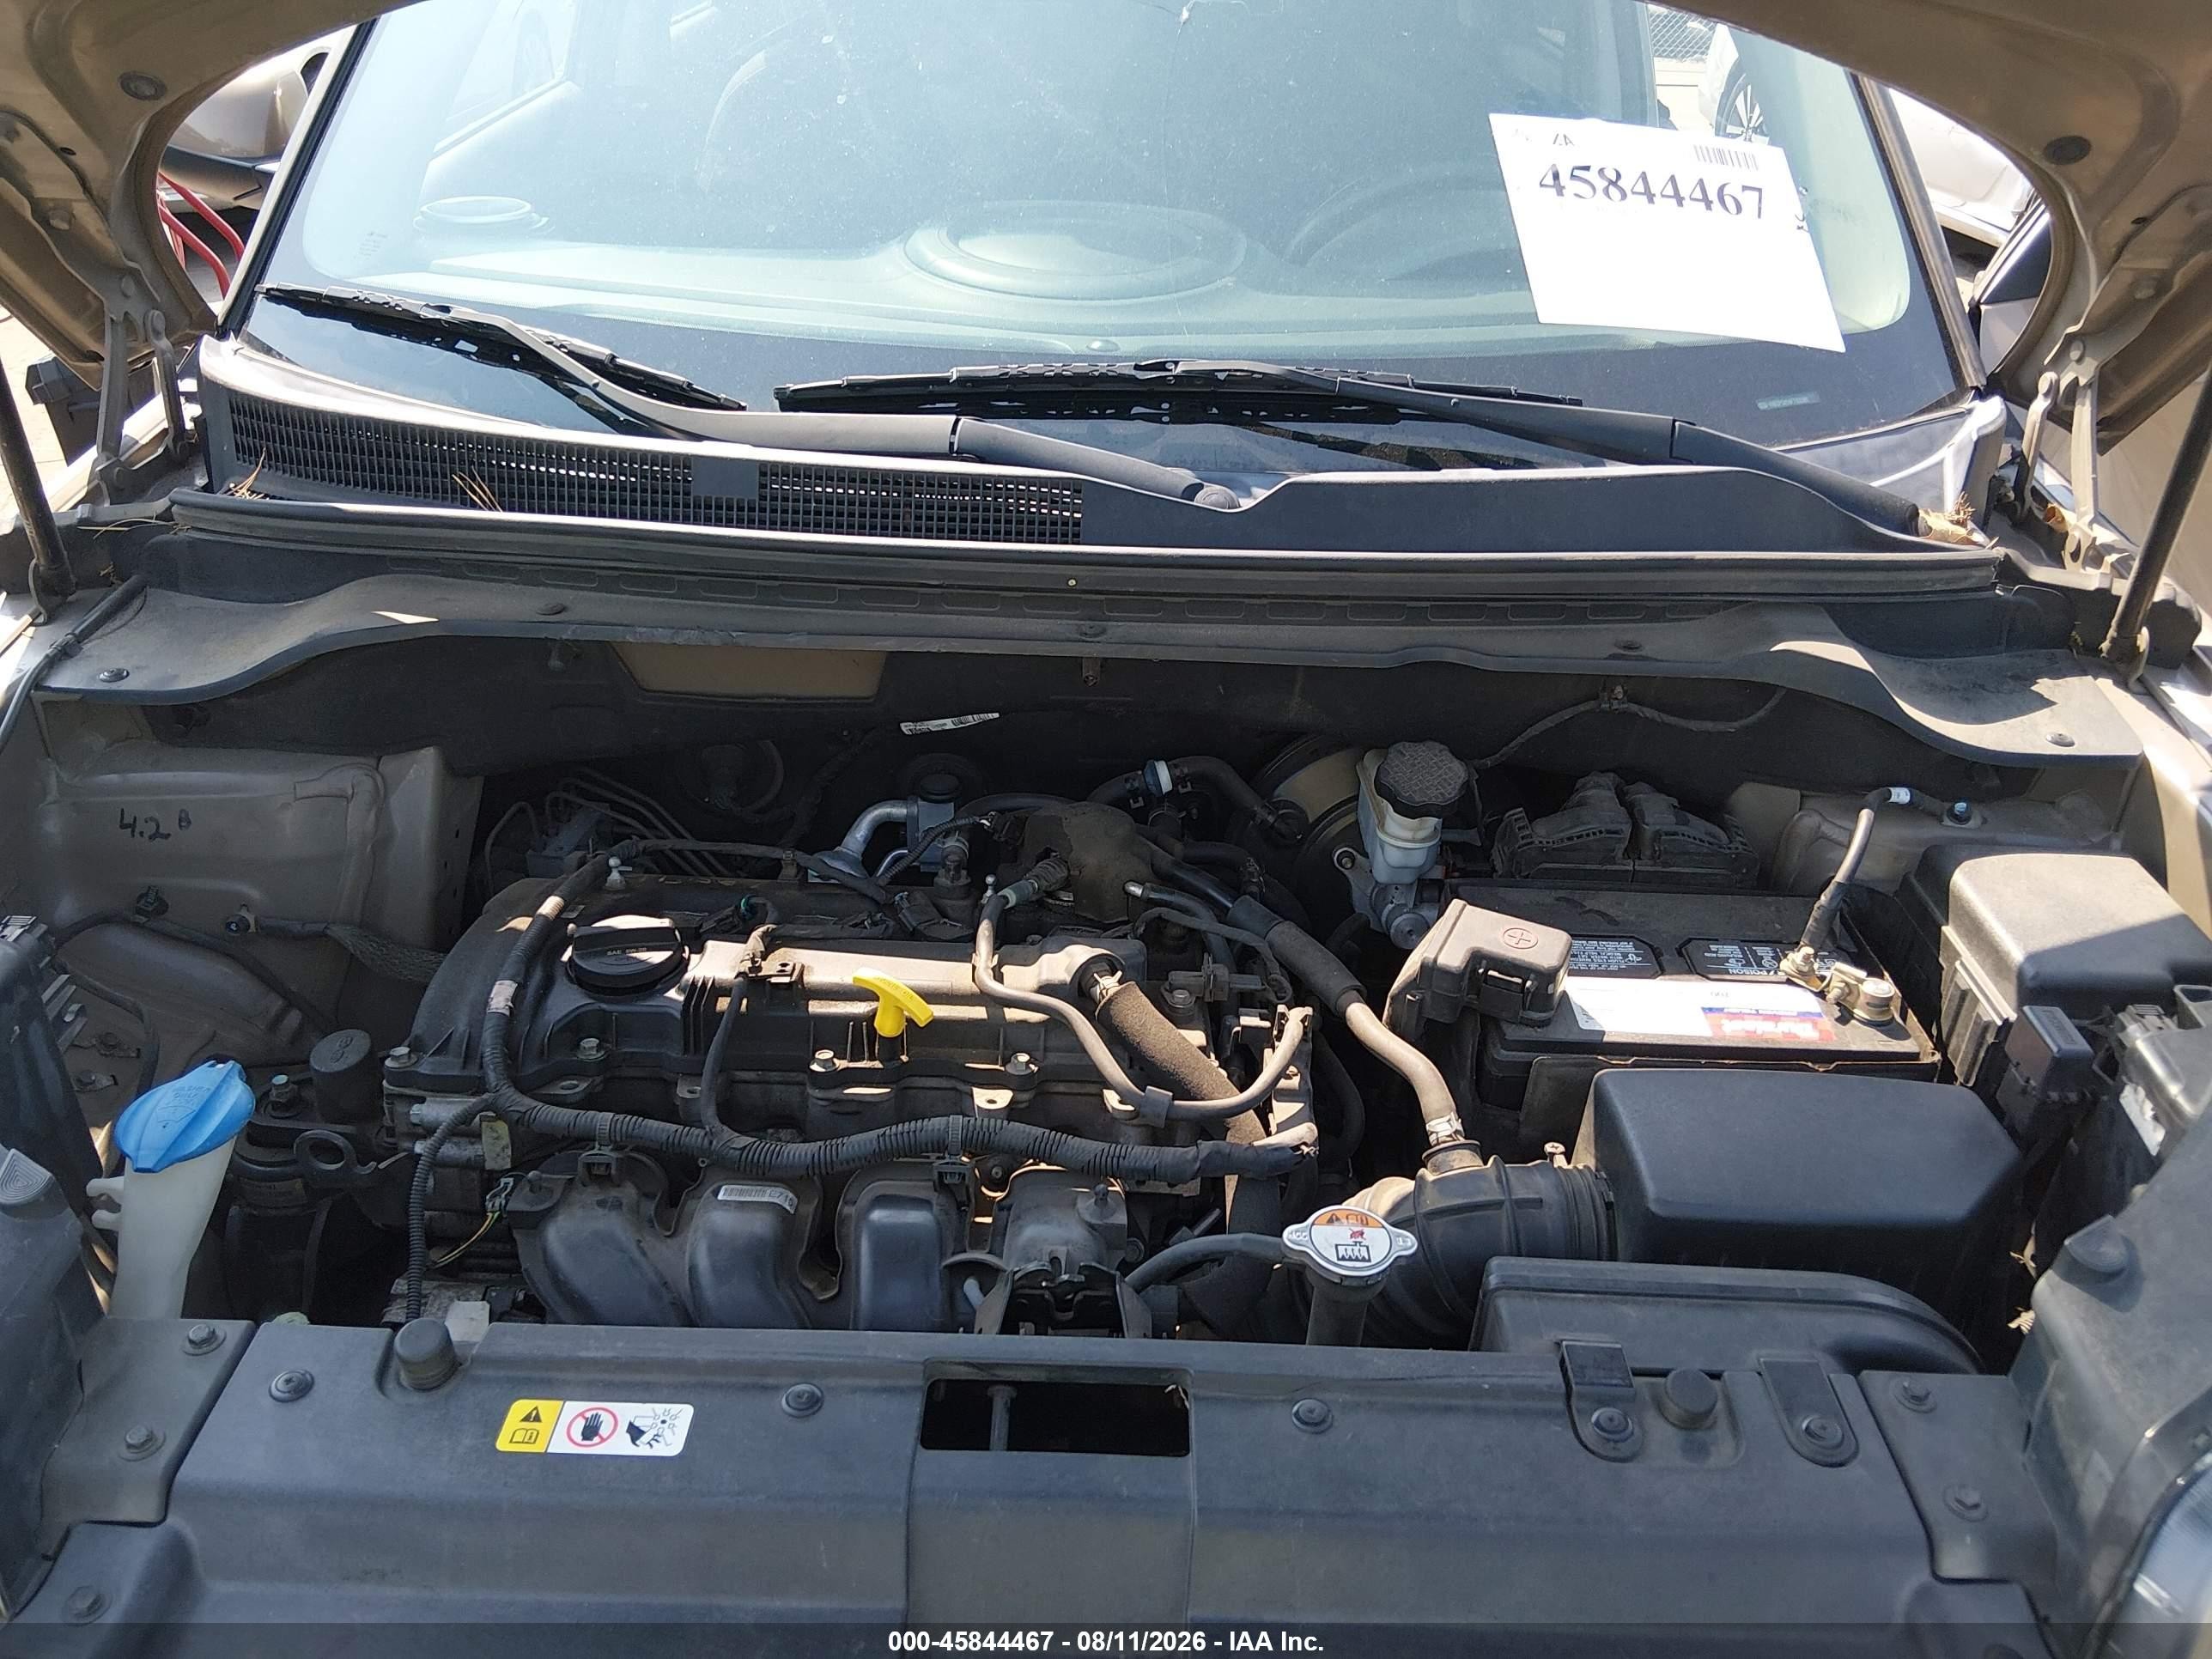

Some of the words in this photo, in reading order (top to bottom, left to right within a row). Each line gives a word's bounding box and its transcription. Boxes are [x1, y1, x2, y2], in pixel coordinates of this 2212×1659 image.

[1539, 163, 1763, 219] 45844467
[118, 807, 172, 843] 4.2
[1728, 968, 1767, 976] POISON
